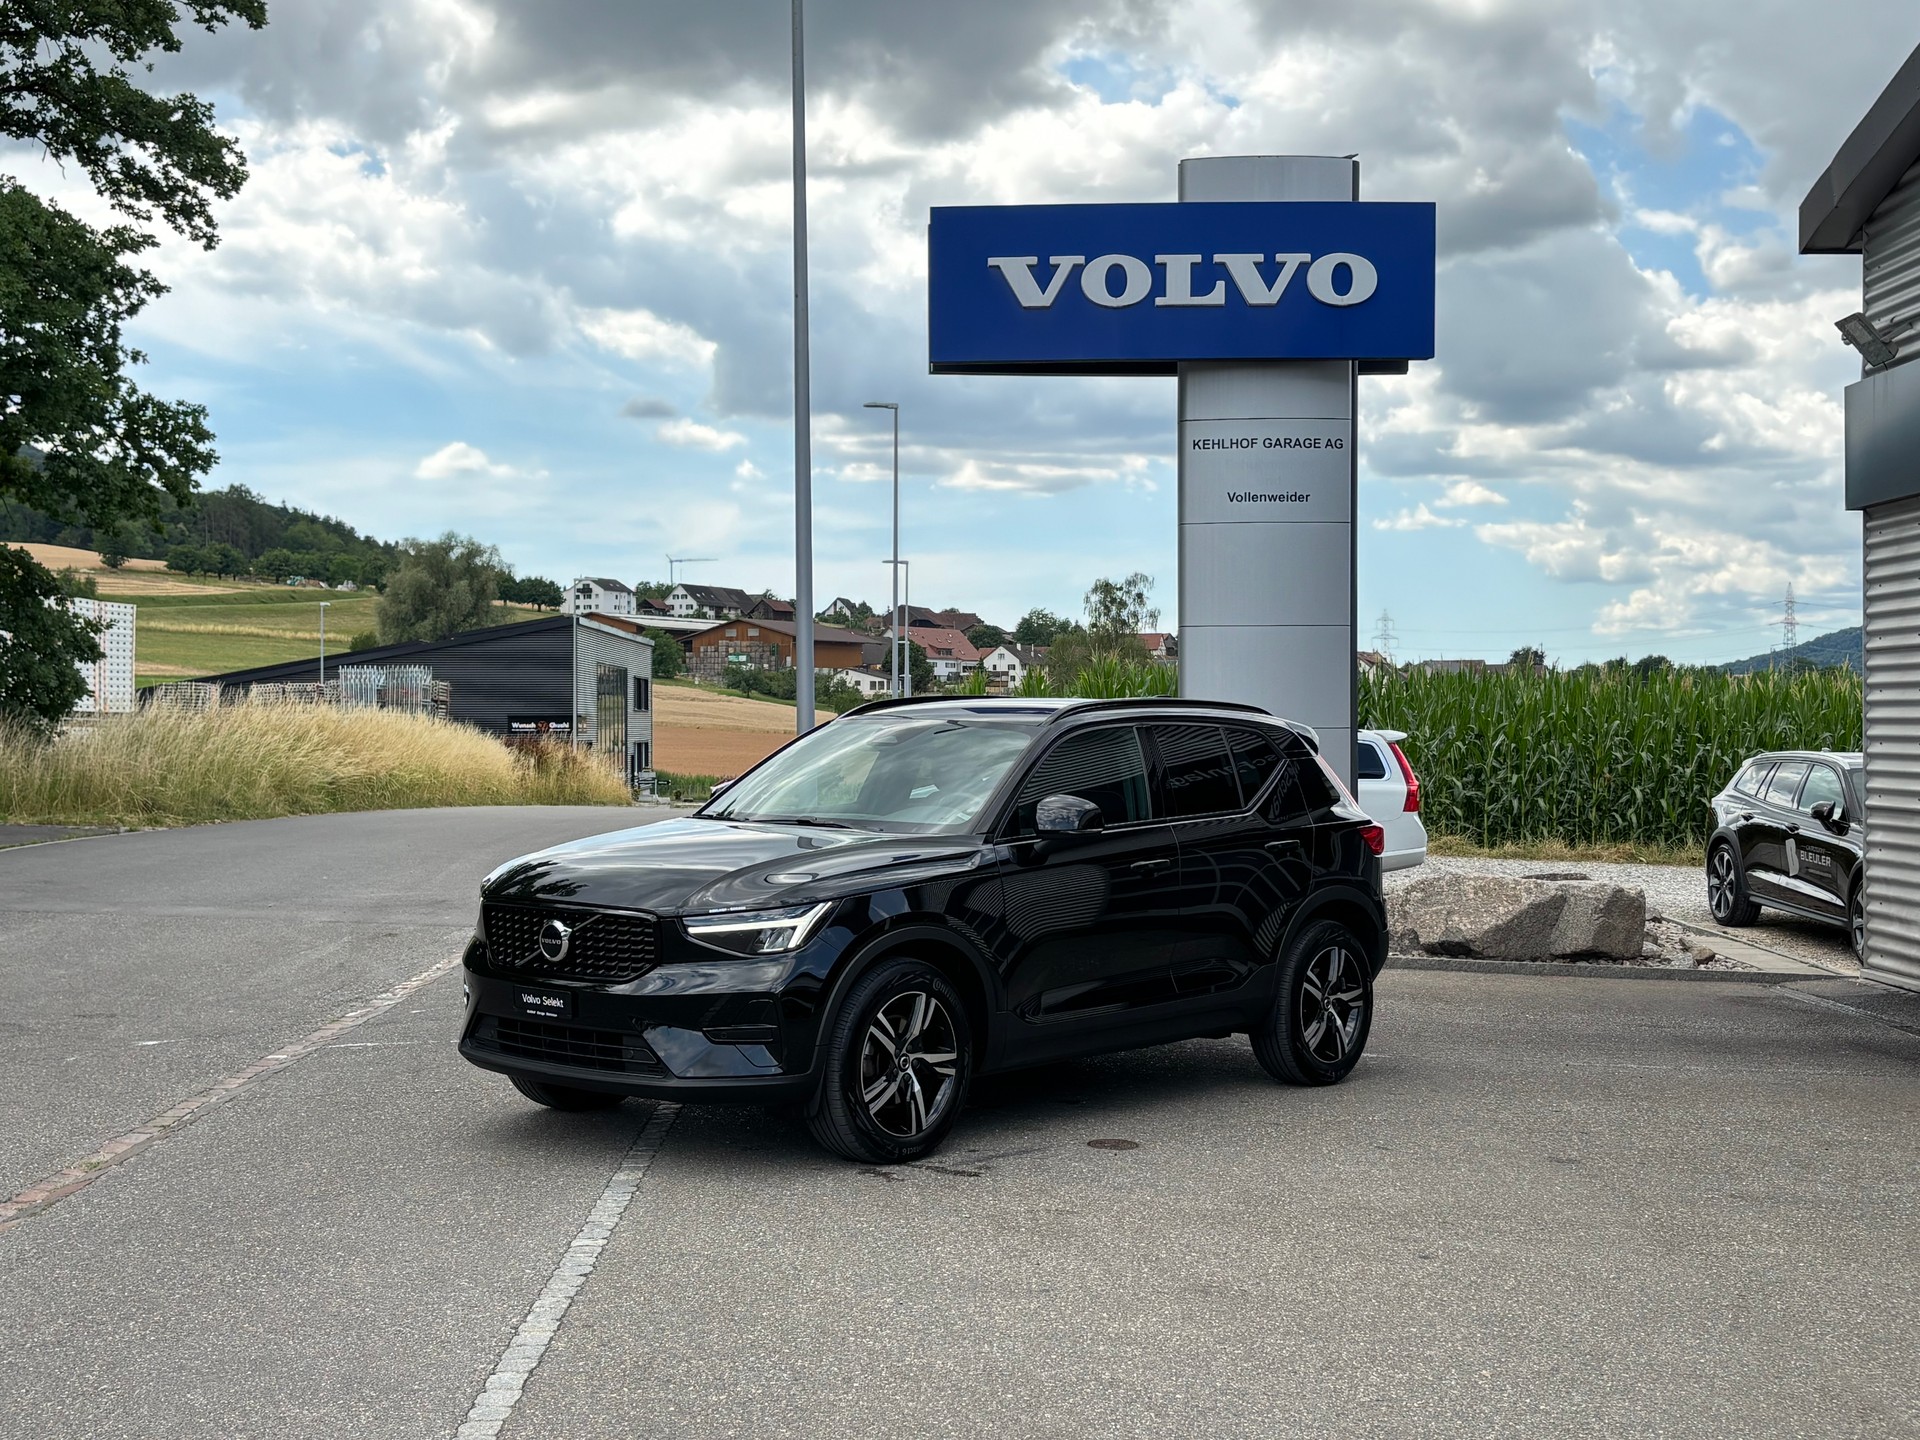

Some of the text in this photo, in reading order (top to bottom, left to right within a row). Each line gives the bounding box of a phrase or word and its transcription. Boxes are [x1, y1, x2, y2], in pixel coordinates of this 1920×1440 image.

[987, 252, 1378, 309] VOLVO
[1192, 437, 1344, 450] KEHLHOF GARAGE AG
[1227, 491, 1311, 503] Vollenweider
[511, 721, 537, 729] Wunsch
[1800, 850, 1831, 867] BLEULER
[541, 937, 562, 945] VOLVO
[521, 993, 564, 1008] Volvo Selekt
